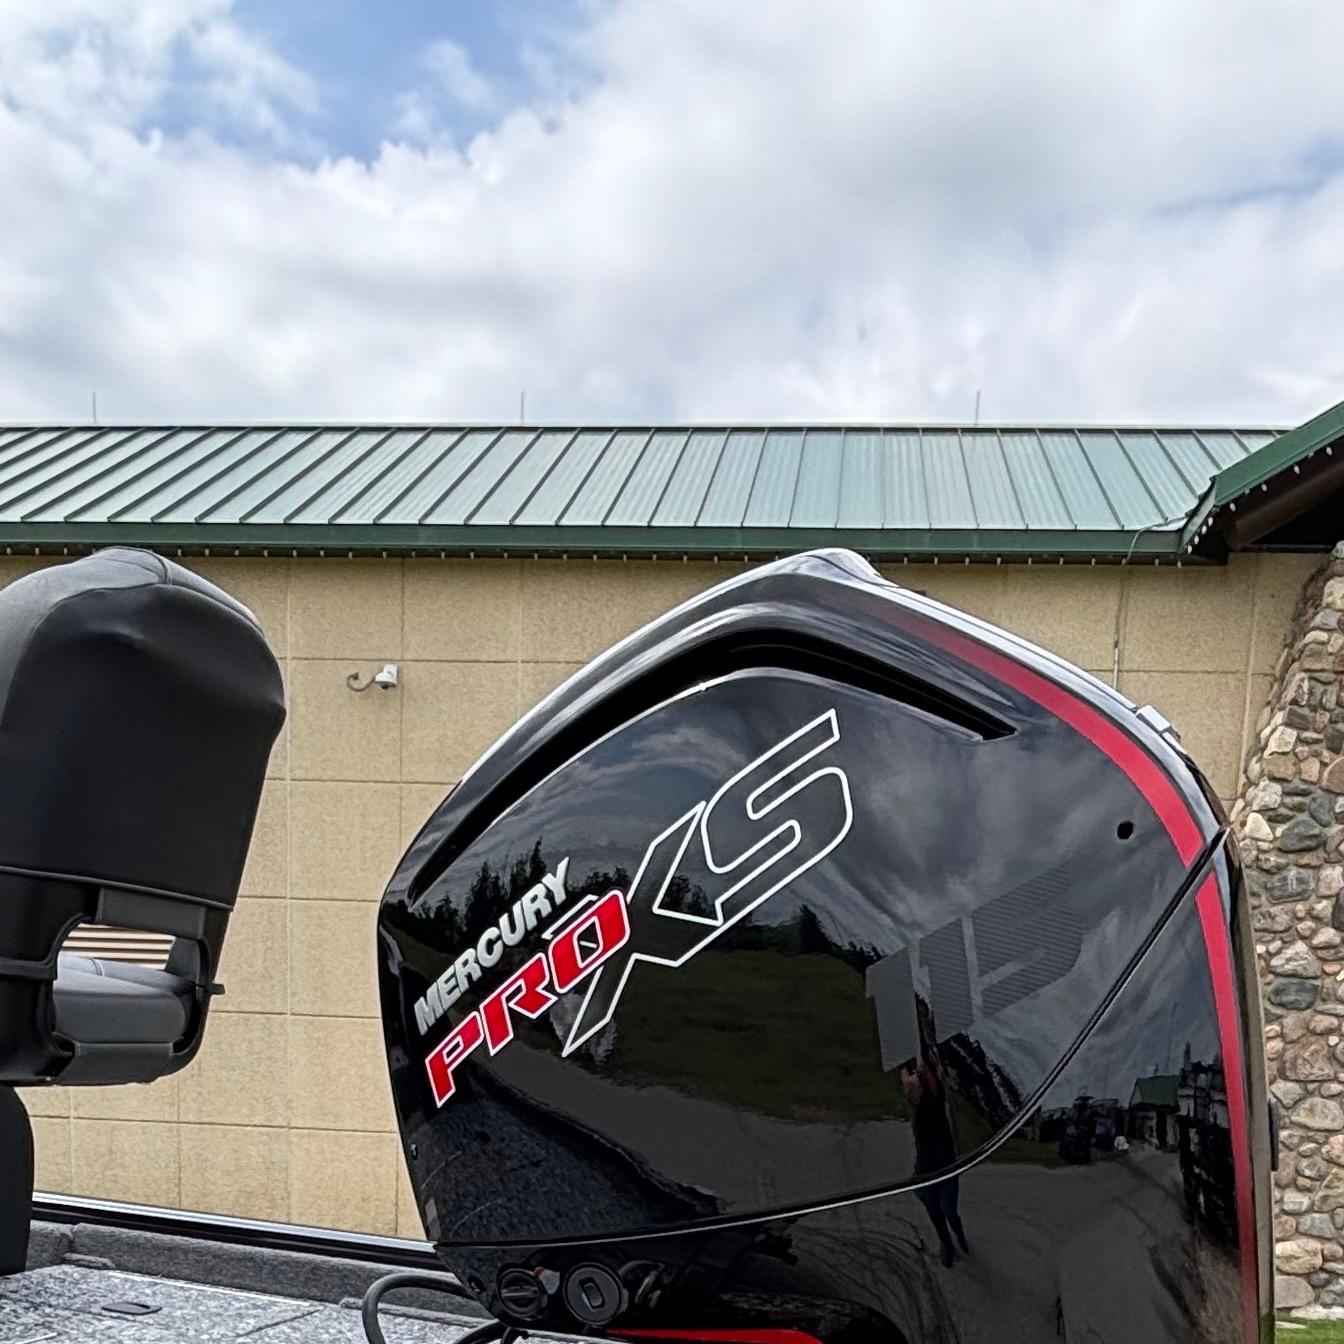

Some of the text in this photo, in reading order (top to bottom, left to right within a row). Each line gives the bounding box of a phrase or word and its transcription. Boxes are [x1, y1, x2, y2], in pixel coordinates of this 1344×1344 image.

[414, 856, 570, 1035] MERCURY
[425, 708, 854, 1109] PRO XS
